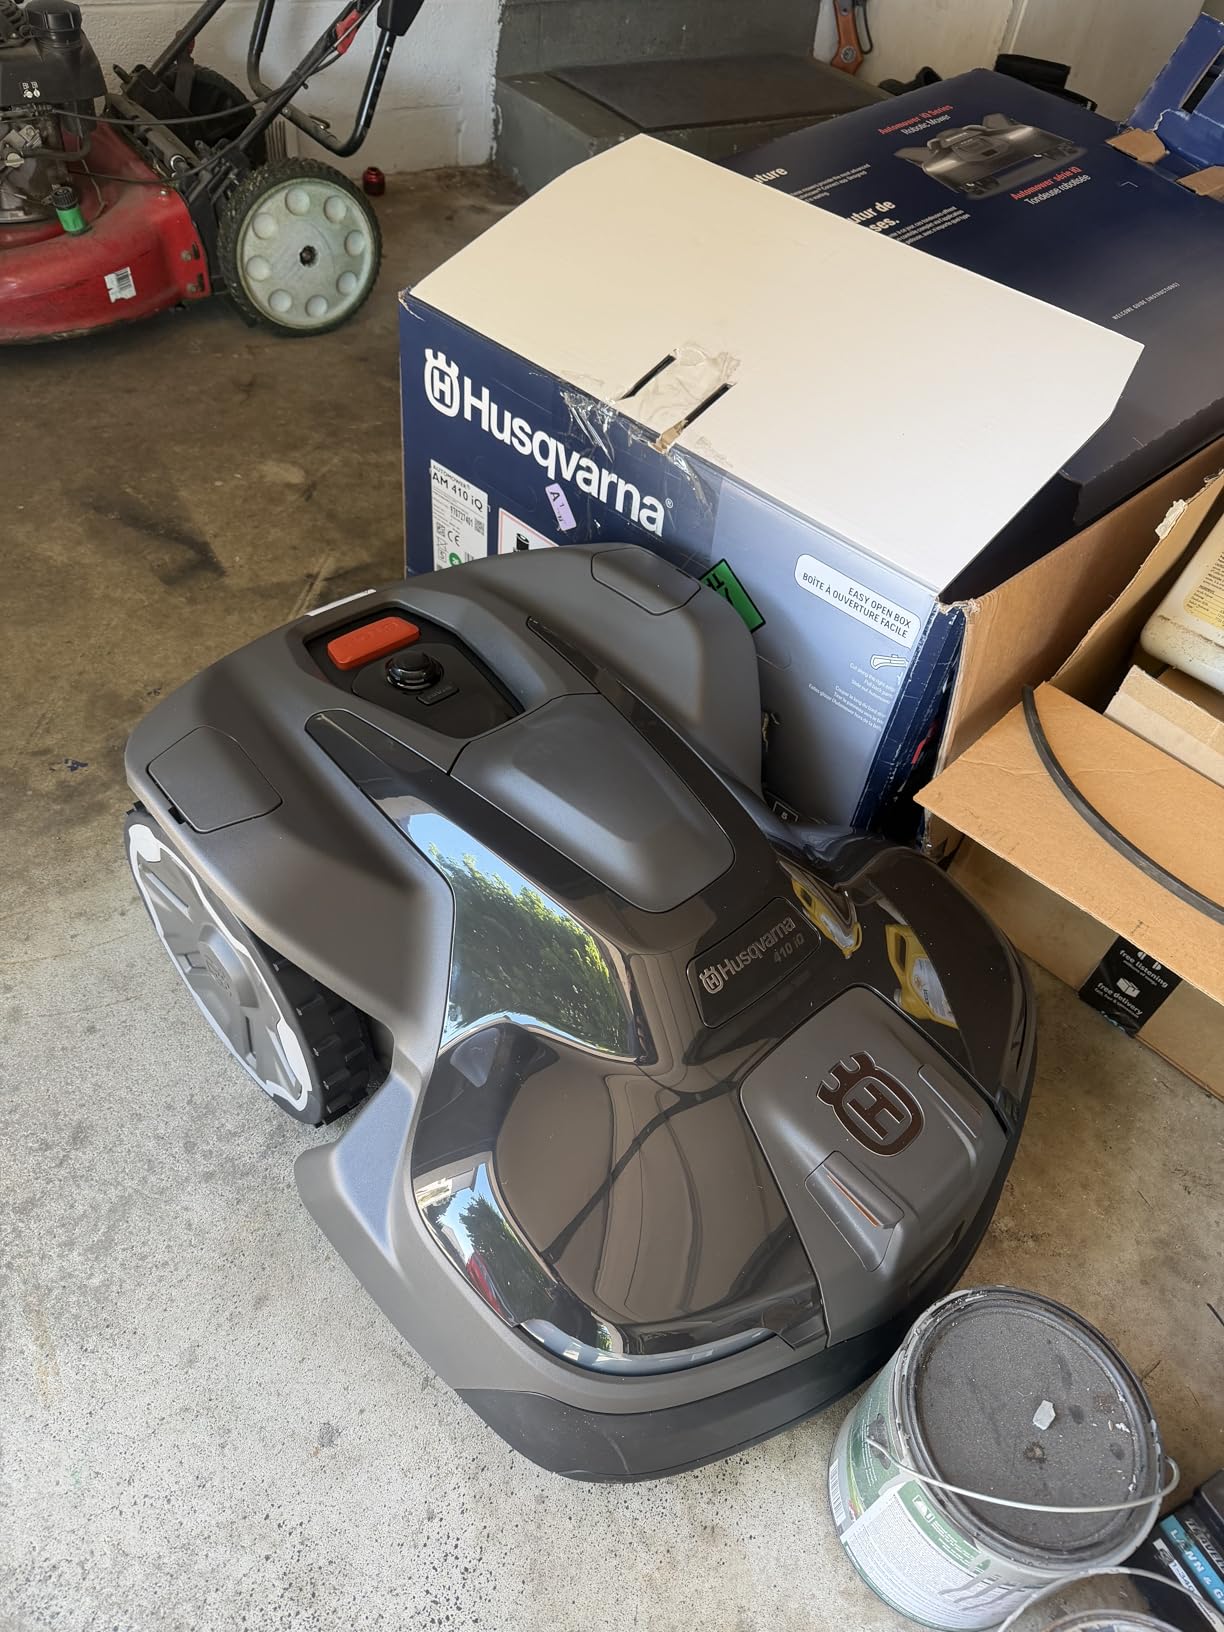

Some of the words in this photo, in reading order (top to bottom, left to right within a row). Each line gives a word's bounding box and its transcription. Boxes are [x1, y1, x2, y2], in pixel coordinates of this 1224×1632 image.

[875, 201, 896, 213] de
[1024, 187, 1061, 205] Tondeuse
[1112, 306, 1134, 320] WELCOME
[1132, 299, 1147, 309] GUIDE
[433, 472, 449, 489] AM
[451, 484, 468, 502] 410
[471, 495, 483, 512] iQ
[802, 571, 825, 591] BOÎTE
[825, 584, 832, 596] À
[832, 590, 880, 622] OUVERTURE
[880, 617, 908, 639] FACILE
[848, 587, 870, 604] EASY
[870, 600, 894, 618] OPEN
[893, 613, 911, 629] BOX
[717, 917, 796, 981] Husqvarna
[774, 941, 793, 962] 410
[793, 933, 805, 949] iQ
[1119, 949, 1135, 963] free
[1135, 959, 1169, 989] listening
[1097, 982, 1113, 995] free
[1113, 990, 1143, 1015] delivery
[1203, 1576, 1213, 1586] &
